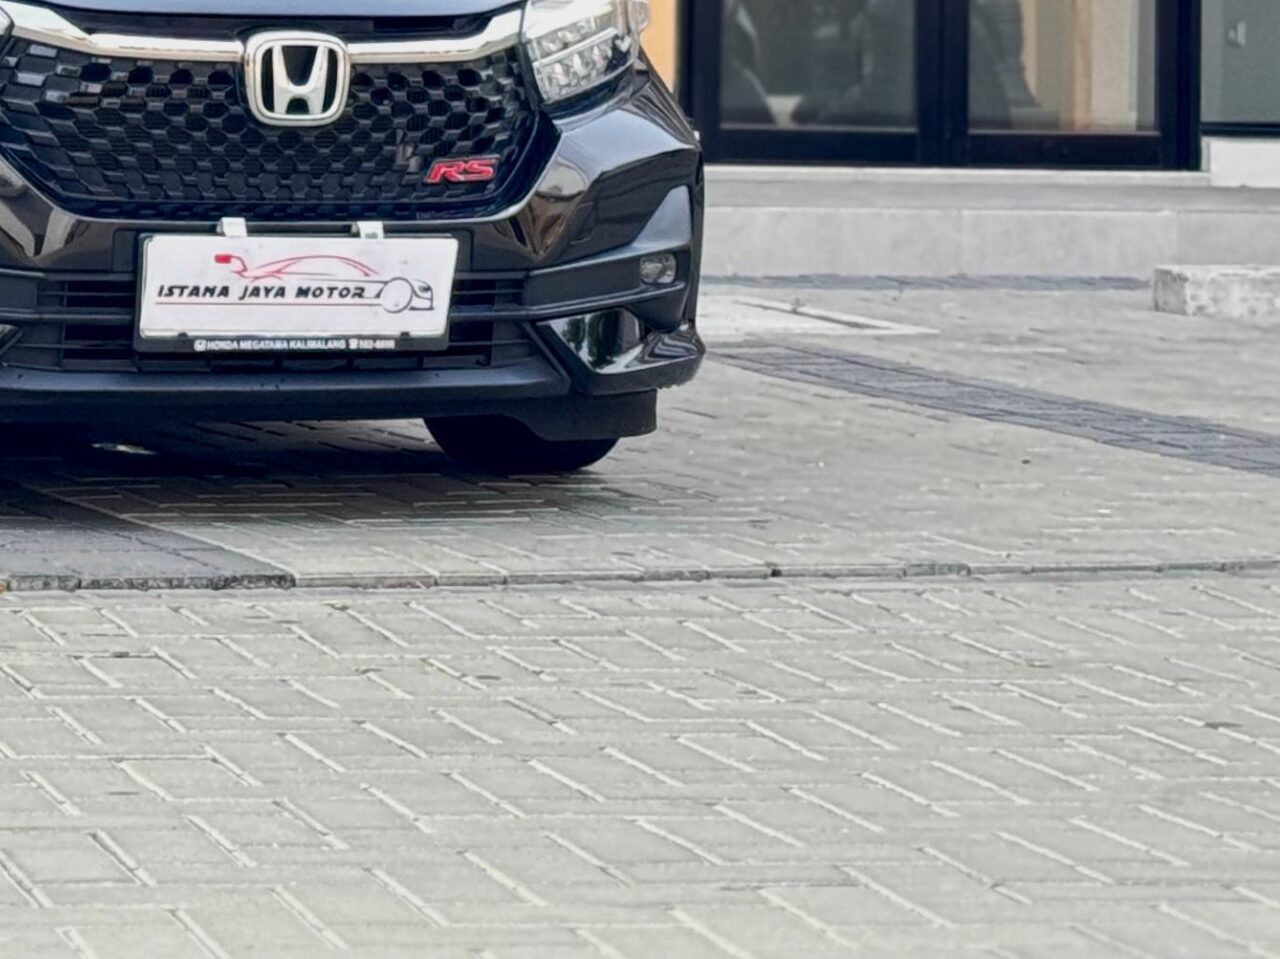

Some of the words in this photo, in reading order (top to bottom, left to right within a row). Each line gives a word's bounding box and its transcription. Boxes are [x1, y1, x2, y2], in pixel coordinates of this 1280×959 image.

[425, 156, 499, 183] RS
[157, 285, 230, 298] ISTANA
[239, 285, 286, 300] JAYA
[295, 286, 365, 299] MOTOR
